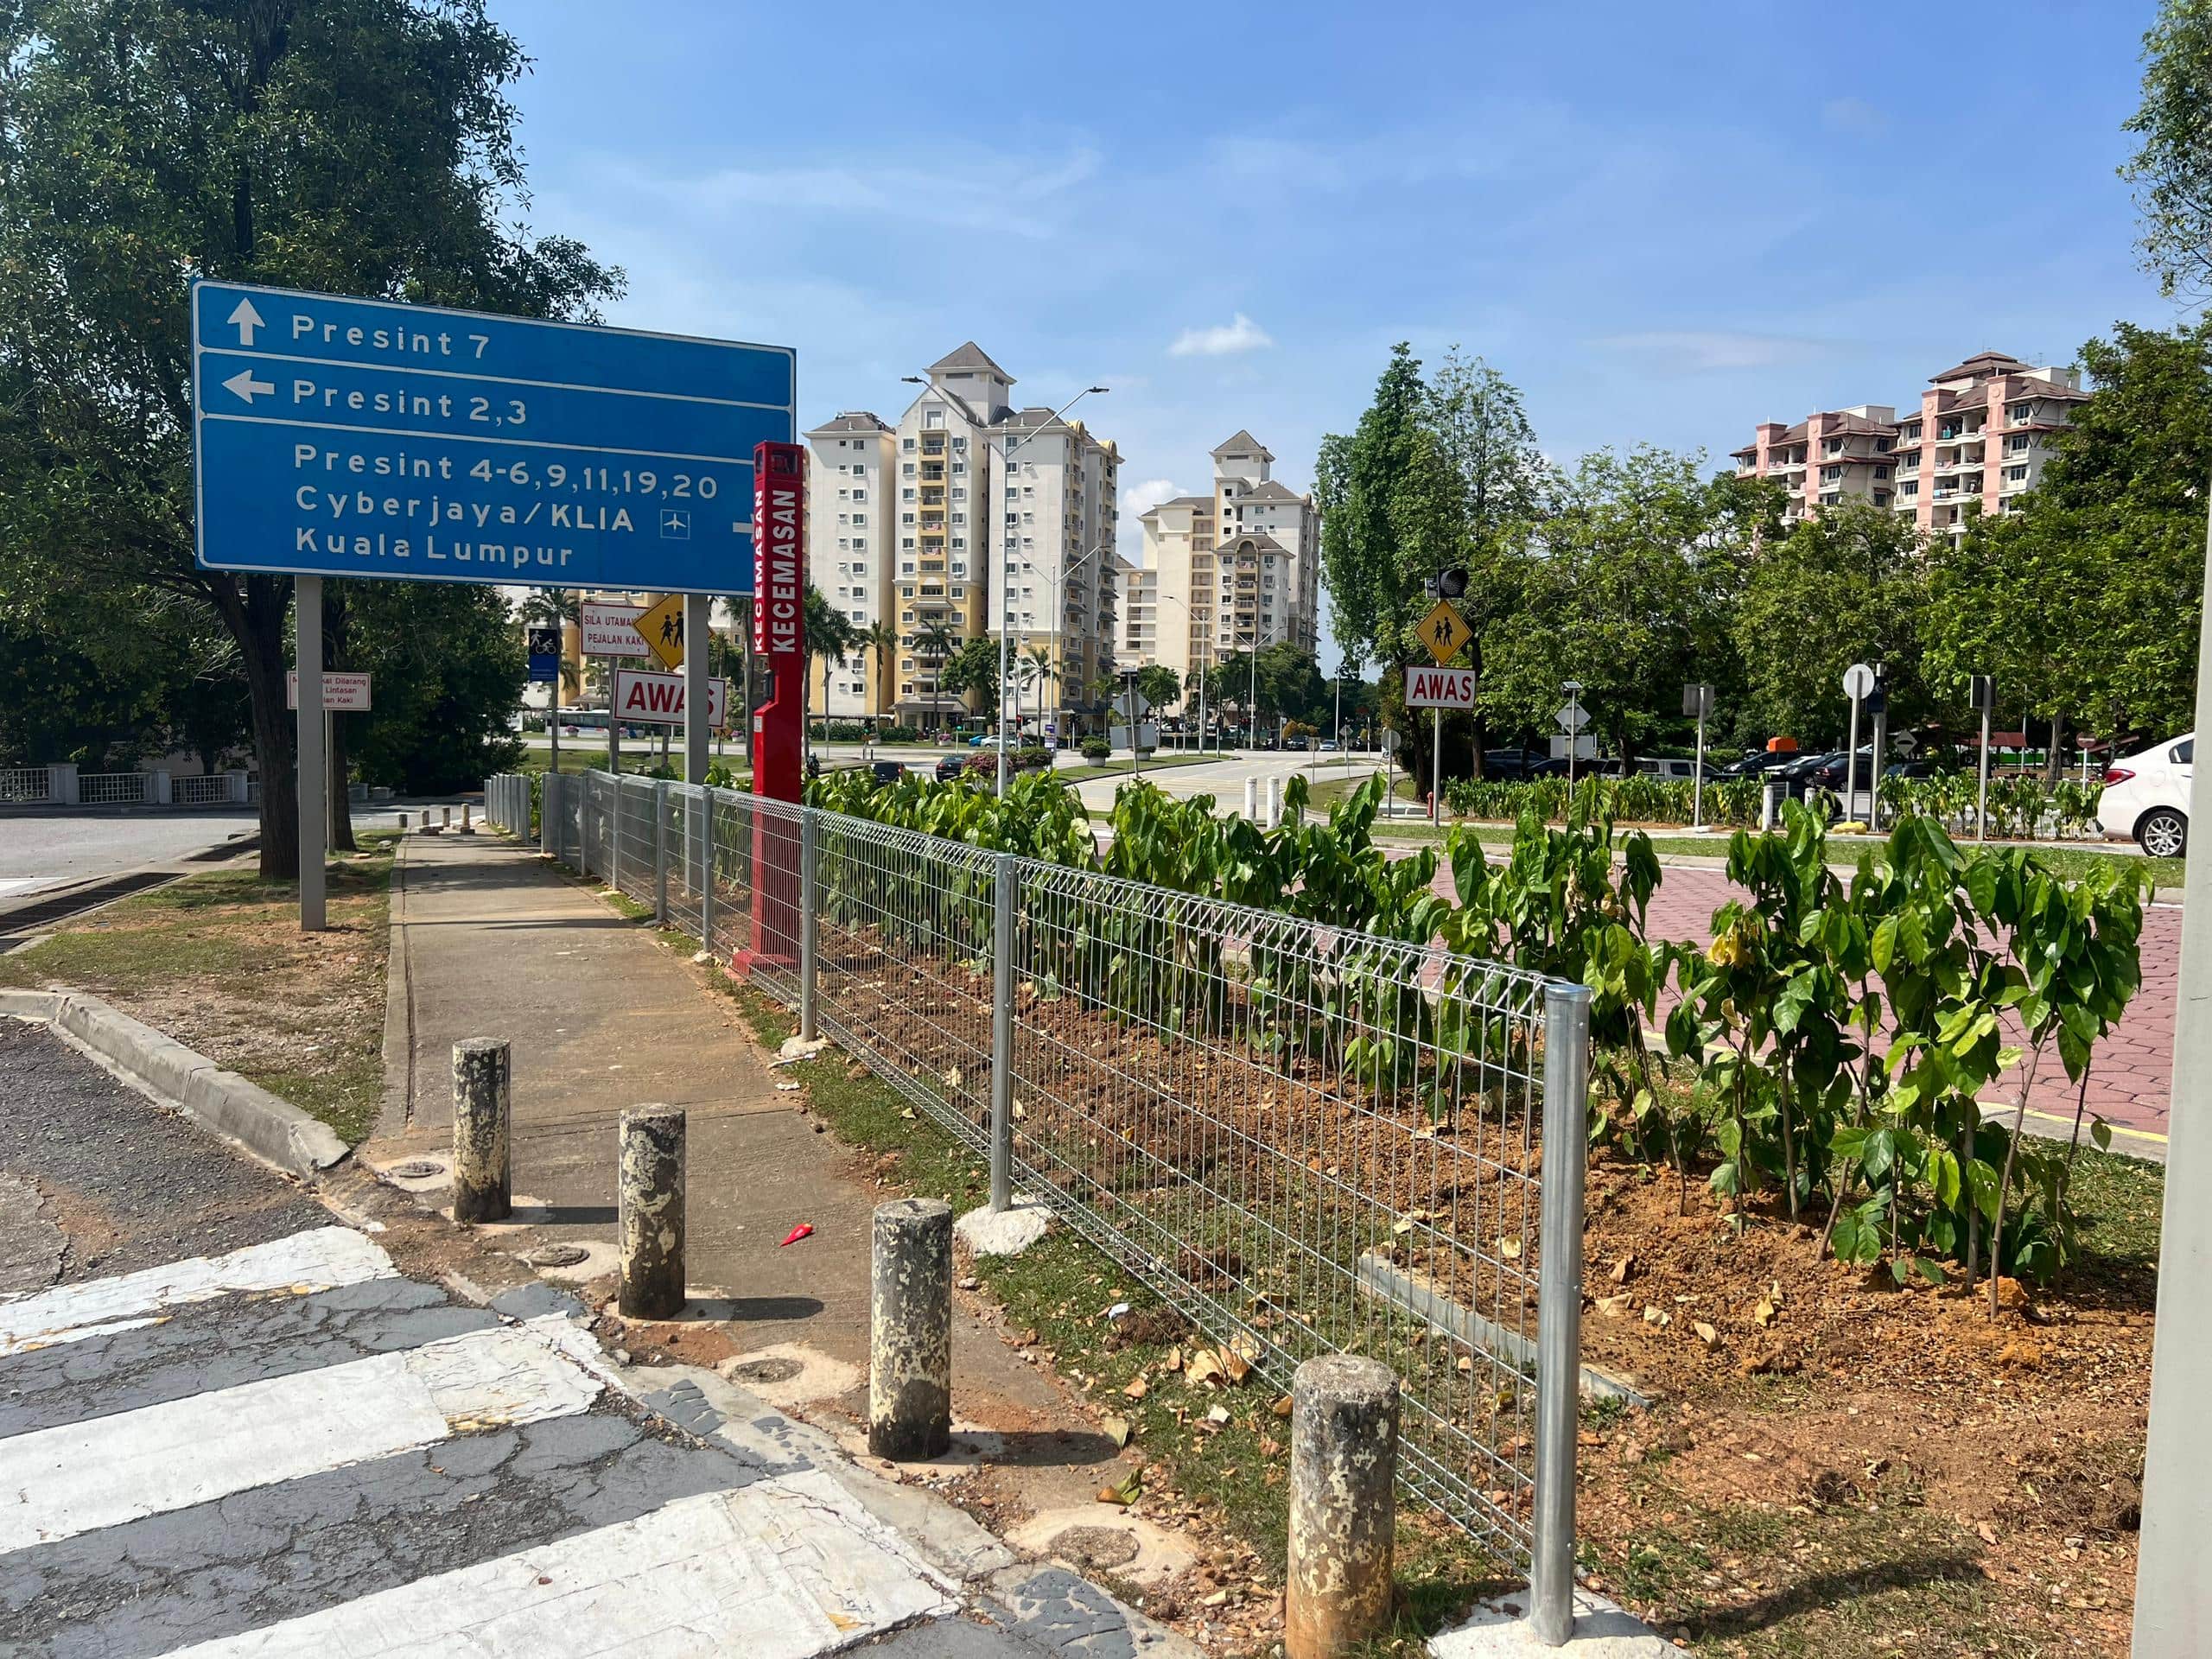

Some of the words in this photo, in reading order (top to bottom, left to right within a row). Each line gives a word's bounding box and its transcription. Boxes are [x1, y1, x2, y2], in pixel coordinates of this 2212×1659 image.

[292, 315, 451, 356] Presint
[468, 334, 490, 359] 7
[294, 379, 452, 418] Presint
[469, 396, 527, 427] 2,3
[295, 444, 452, 480] Presint
[296, 486, 635, 532] Cyberjaya/KLIA
[296, 527, 411, 557] Kuala
[427, 535, 573, 569] Lumpur
[754, 490, 763, 652] KECEMASAN
[772, 490, 795, 652] KECEMASAN
[584, 615, 601, 626] SILA
[605, 616, 635, 627] UTAMA
[588, 632, 622, 645] PEJALAN
[1412, 673, 1472, 702] AWAS
